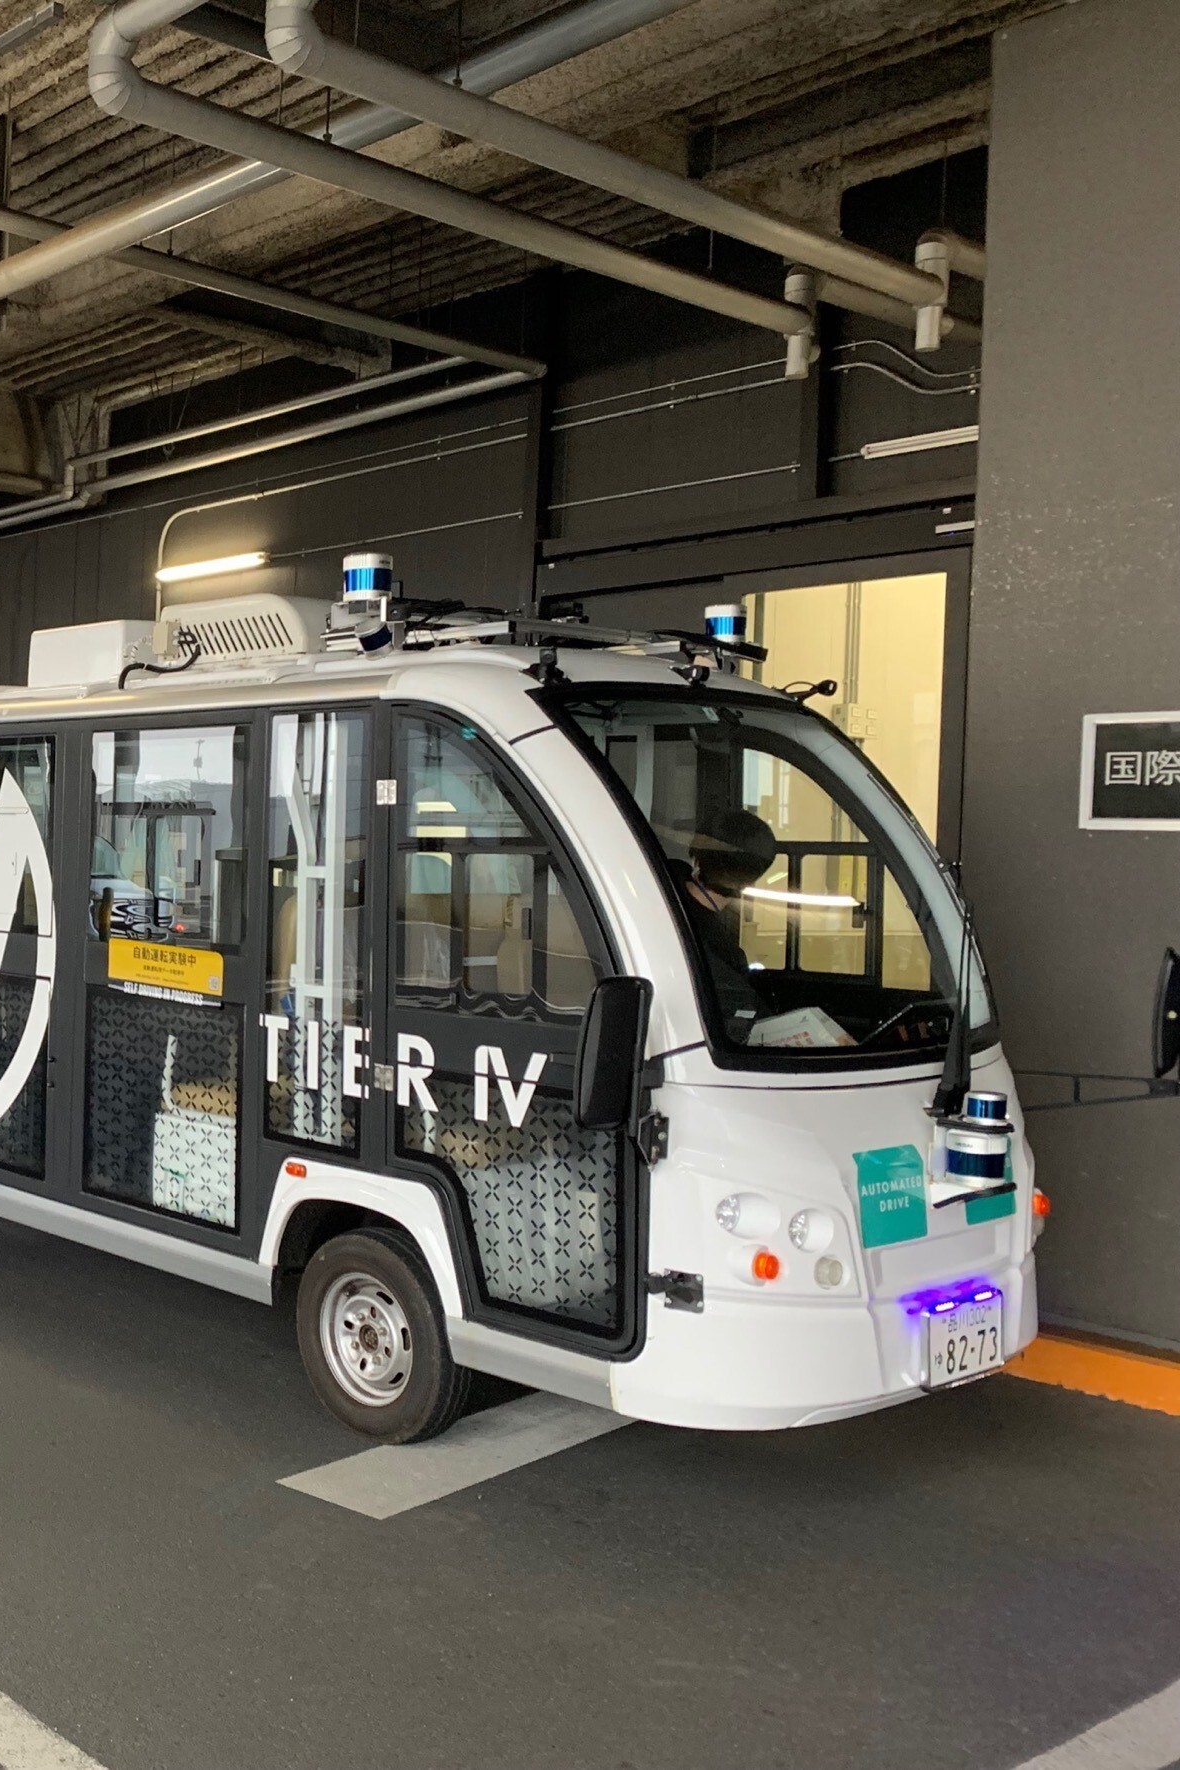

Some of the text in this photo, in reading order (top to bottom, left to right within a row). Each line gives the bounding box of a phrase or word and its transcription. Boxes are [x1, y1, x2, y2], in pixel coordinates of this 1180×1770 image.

[1105, 750, 1180, 786] 国際
[133, 945, 196, 968] 自動運転実験中
[123, 981, 204, 1007] SELF DRIVING IN PROGRESS
[259, 1012, 548, 1128] TIER IV
[861, 1176, 922, 1197] AUTOMATED
[879, 1196, 910, 1212] DRIVE
